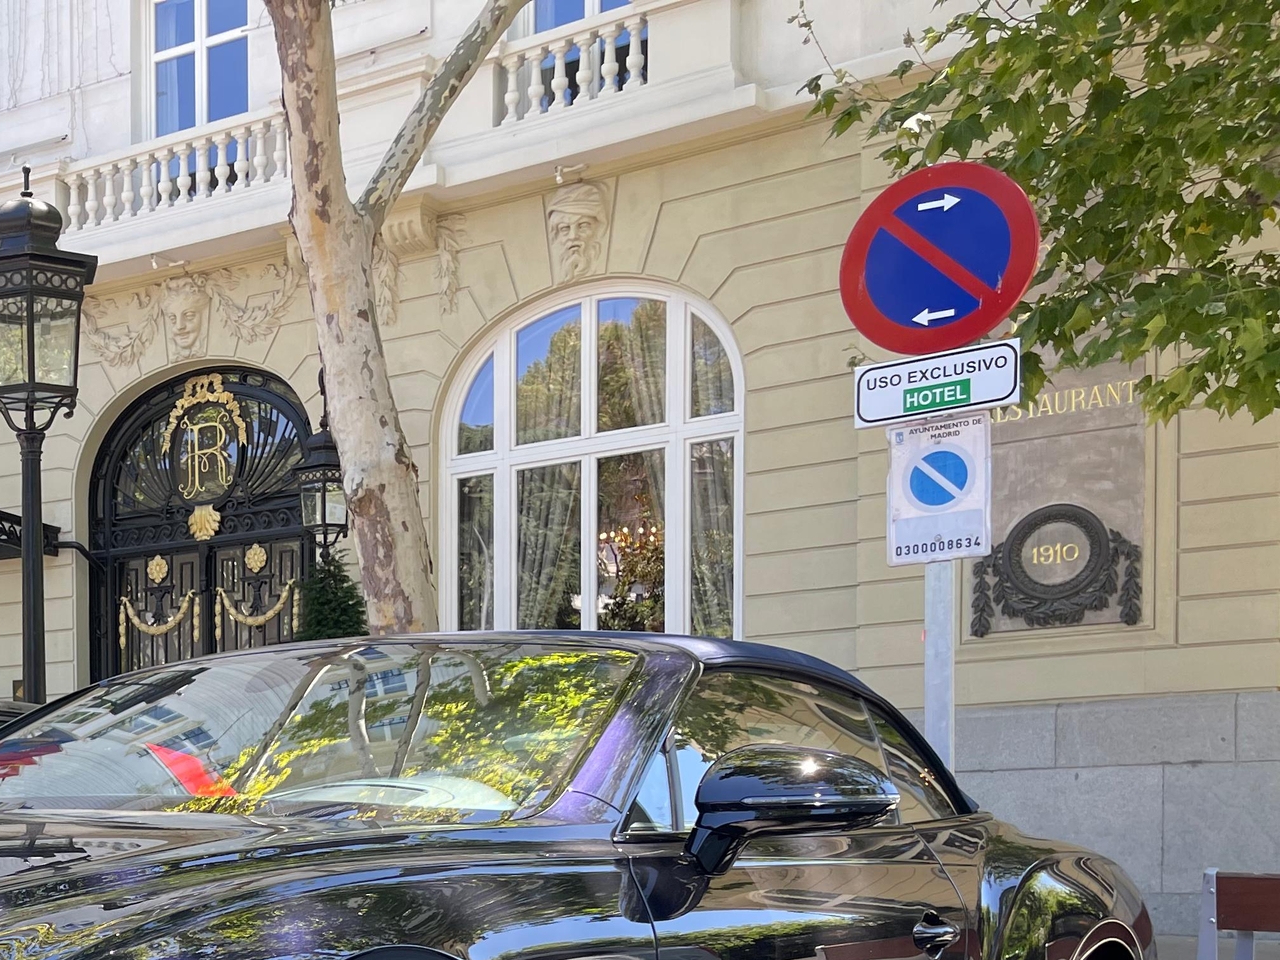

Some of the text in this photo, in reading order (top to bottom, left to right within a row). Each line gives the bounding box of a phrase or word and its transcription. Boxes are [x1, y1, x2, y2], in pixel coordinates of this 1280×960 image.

[866, 355, 1008, 391] USO EXCLUSIVO
[905, 385, 967, 409] HOTEL
[991, 379, 1138, 423] ESTAURANT
[908, 418, 983, 436] AYUNTAMIENTO DE
[930, 429, 961, 440] MADRID
[895, 536, 981, 557] 0300008634
[1031, 542, 1080, 565] 1910
